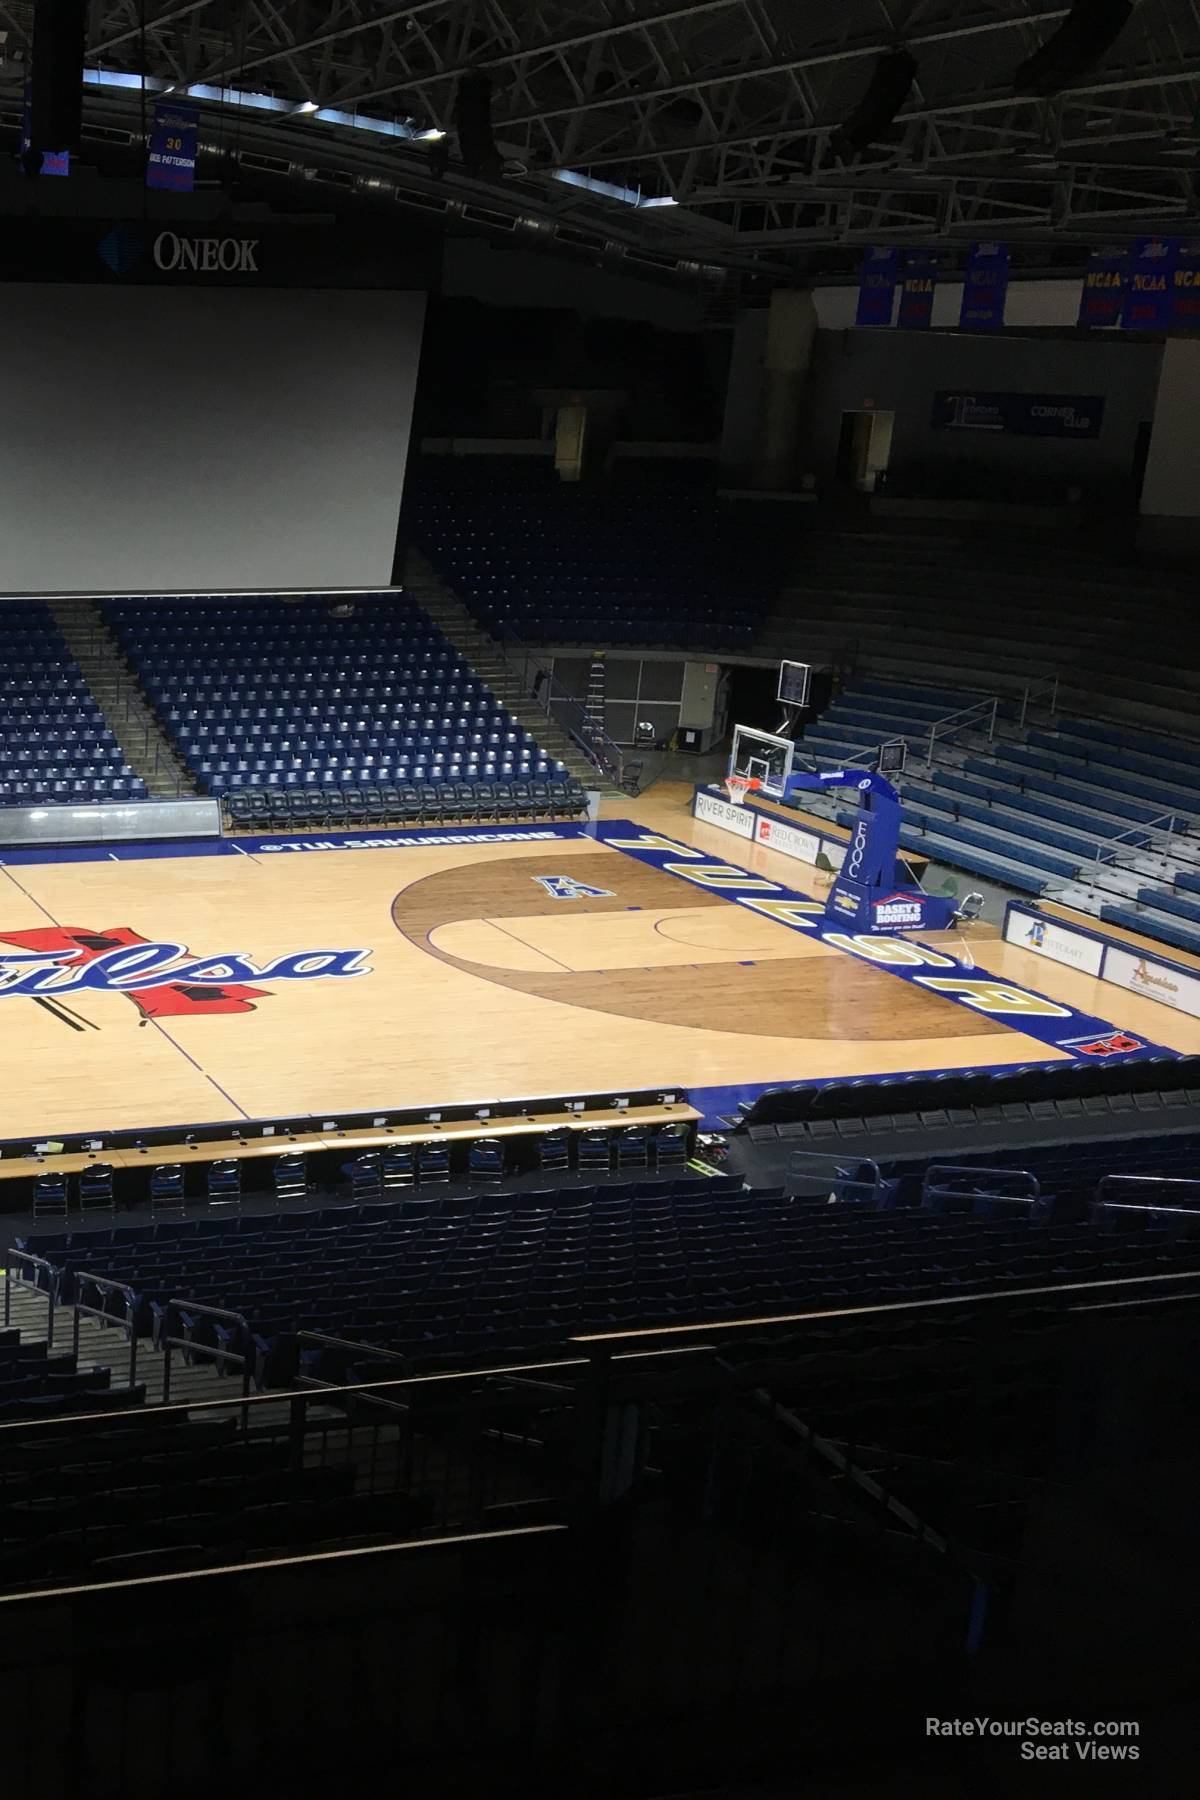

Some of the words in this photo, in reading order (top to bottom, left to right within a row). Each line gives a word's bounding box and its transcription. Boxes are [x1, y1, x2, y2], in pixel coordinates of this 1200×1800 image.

[166, 137, 182, 150] 30
[153, 230, 260, 272] ONEOK
[1087, 271, 1121, 288] NCAA
[1133, 273, 1167, 290] NCAA
[1030, 405, 1076, 418] CORNER
[1063, 415, 1091, 428] CLUB
[696, 796, 725, 819] RIVER
[725, 806, 753, 830] SPIRIT
[876, 903, 921, 915] BASEY'S
[603, 835, 1073, 1017] TULSA
[876, 913, 921, 924] ROOFING
